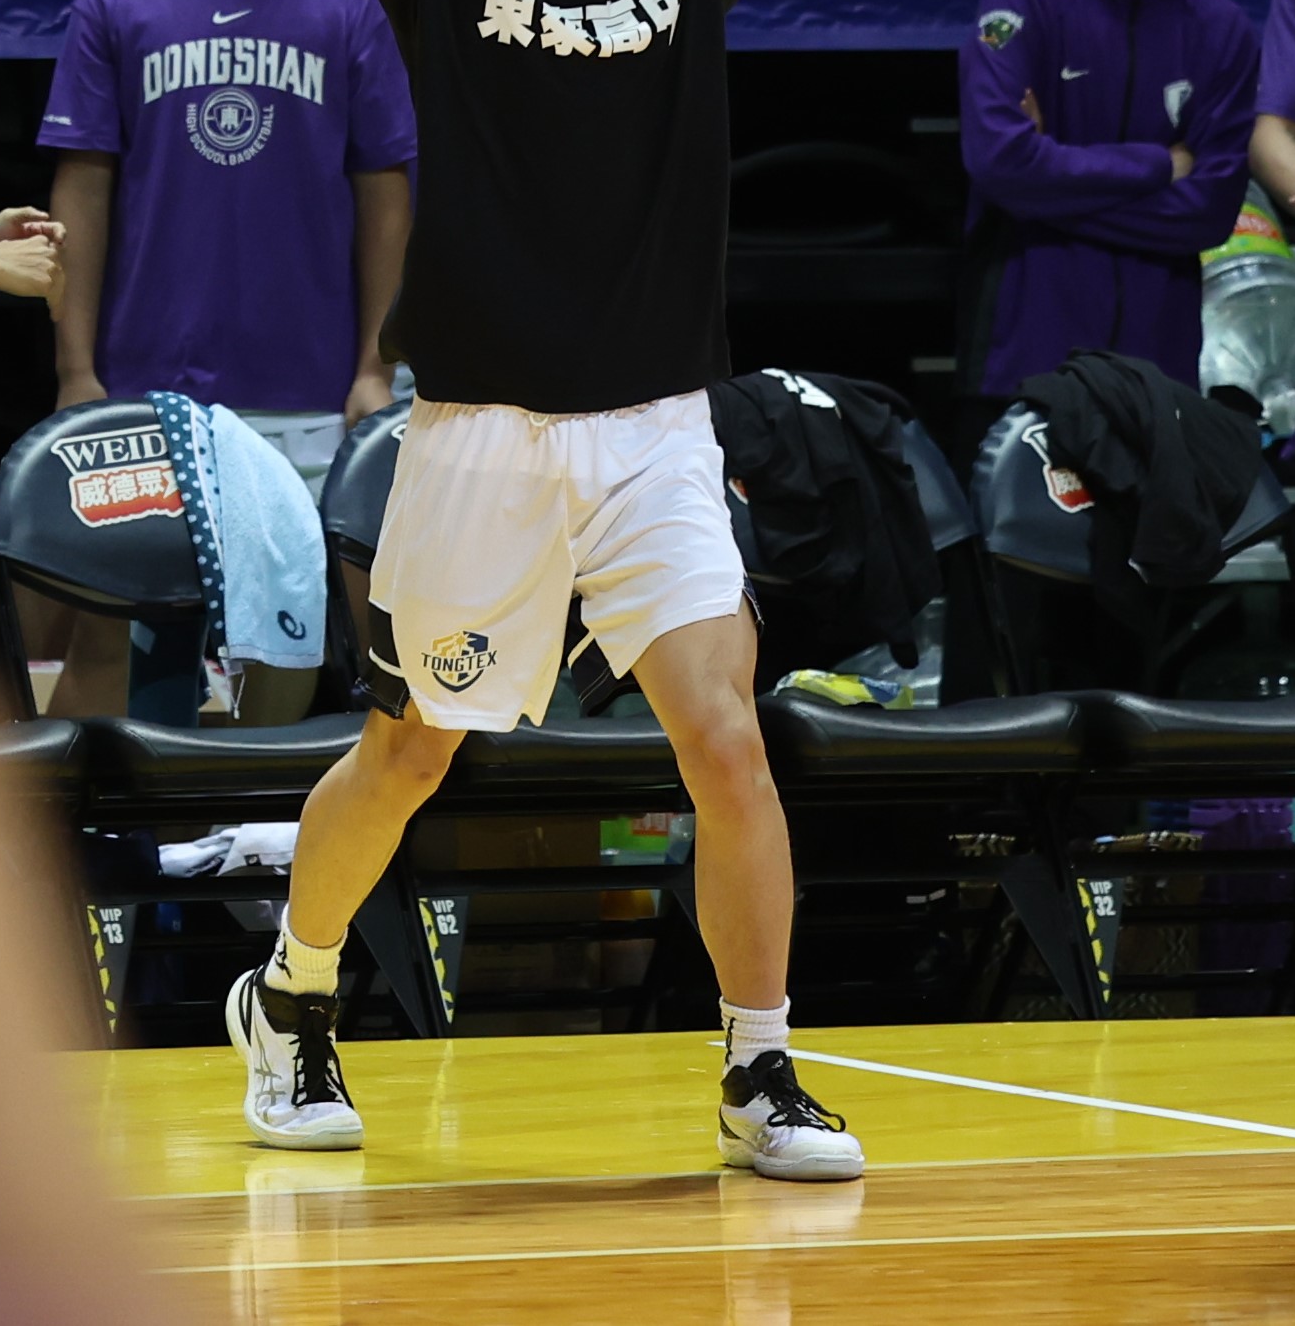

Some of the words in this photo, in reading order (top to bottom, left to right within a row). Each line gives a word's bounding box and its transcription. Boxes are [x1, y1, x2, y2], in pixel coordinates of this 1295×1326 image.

[143, 37, 326, 105] DONGSHAN
[421, 650, 498, 672] TONGTEX
[1089, 880, 1113, 895] VIP
[99, 908, 123, 922] VIP
[432, 899, 455, 914] VIP
[1094, 895, 1117, 917] 32
[103, 923, 124, 945] 13
[436, 914, 460, 936] 62
